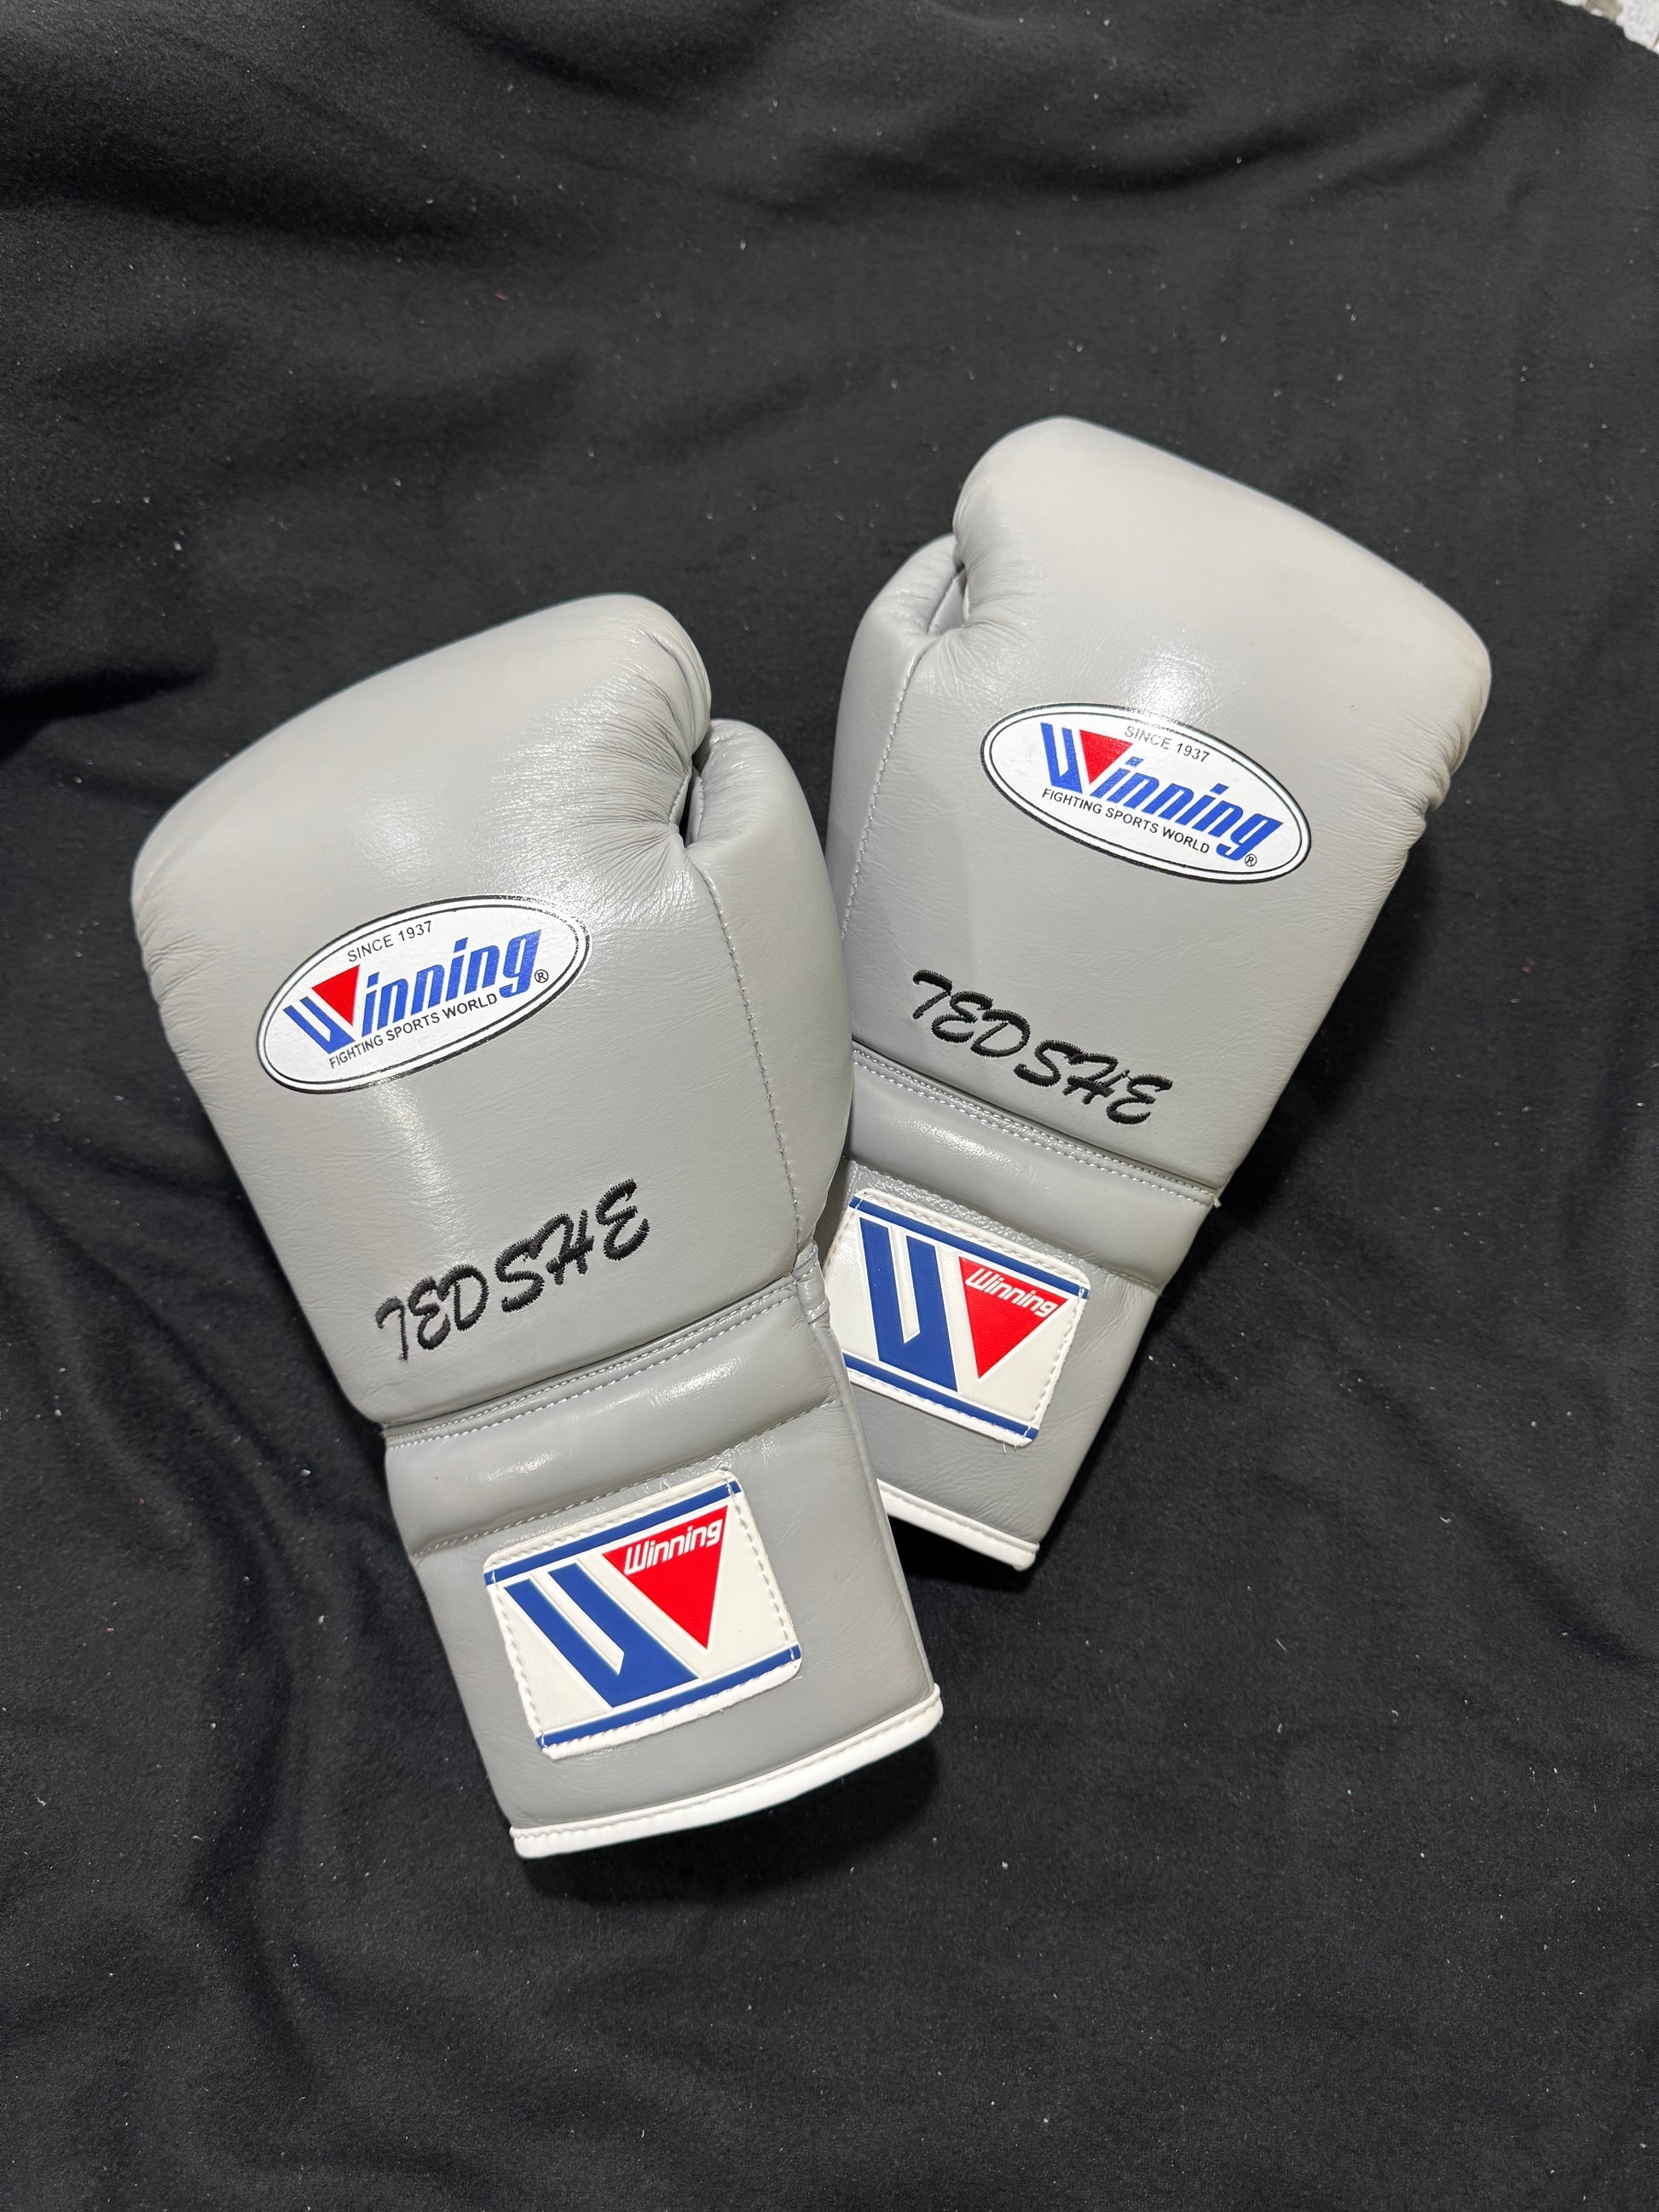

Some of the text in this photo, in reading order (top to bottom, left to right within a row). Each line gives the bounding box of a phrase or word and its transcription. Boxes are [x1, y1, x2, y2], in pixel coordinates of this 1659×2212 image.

[1124, 725, 1211, 763] SINCE 1937
[1040, 722, 1284, 862] Winning
[1042, 788, 1210, 854] FIGHTING SPORTS WORLD
[347, 920, 433, 962] SINCE 1937
[282, 929, 542, 1054] Winning
[328, 992, 498, 1069] FIGHTING SPORTS WORLD
[912, 969, 1174, 1125] TED SHE
[375, 1178, 650, 1363] TED SHE
[964, 1268, 1059, 1318] Winning
[623, 1518, 724, 1576] Winning
